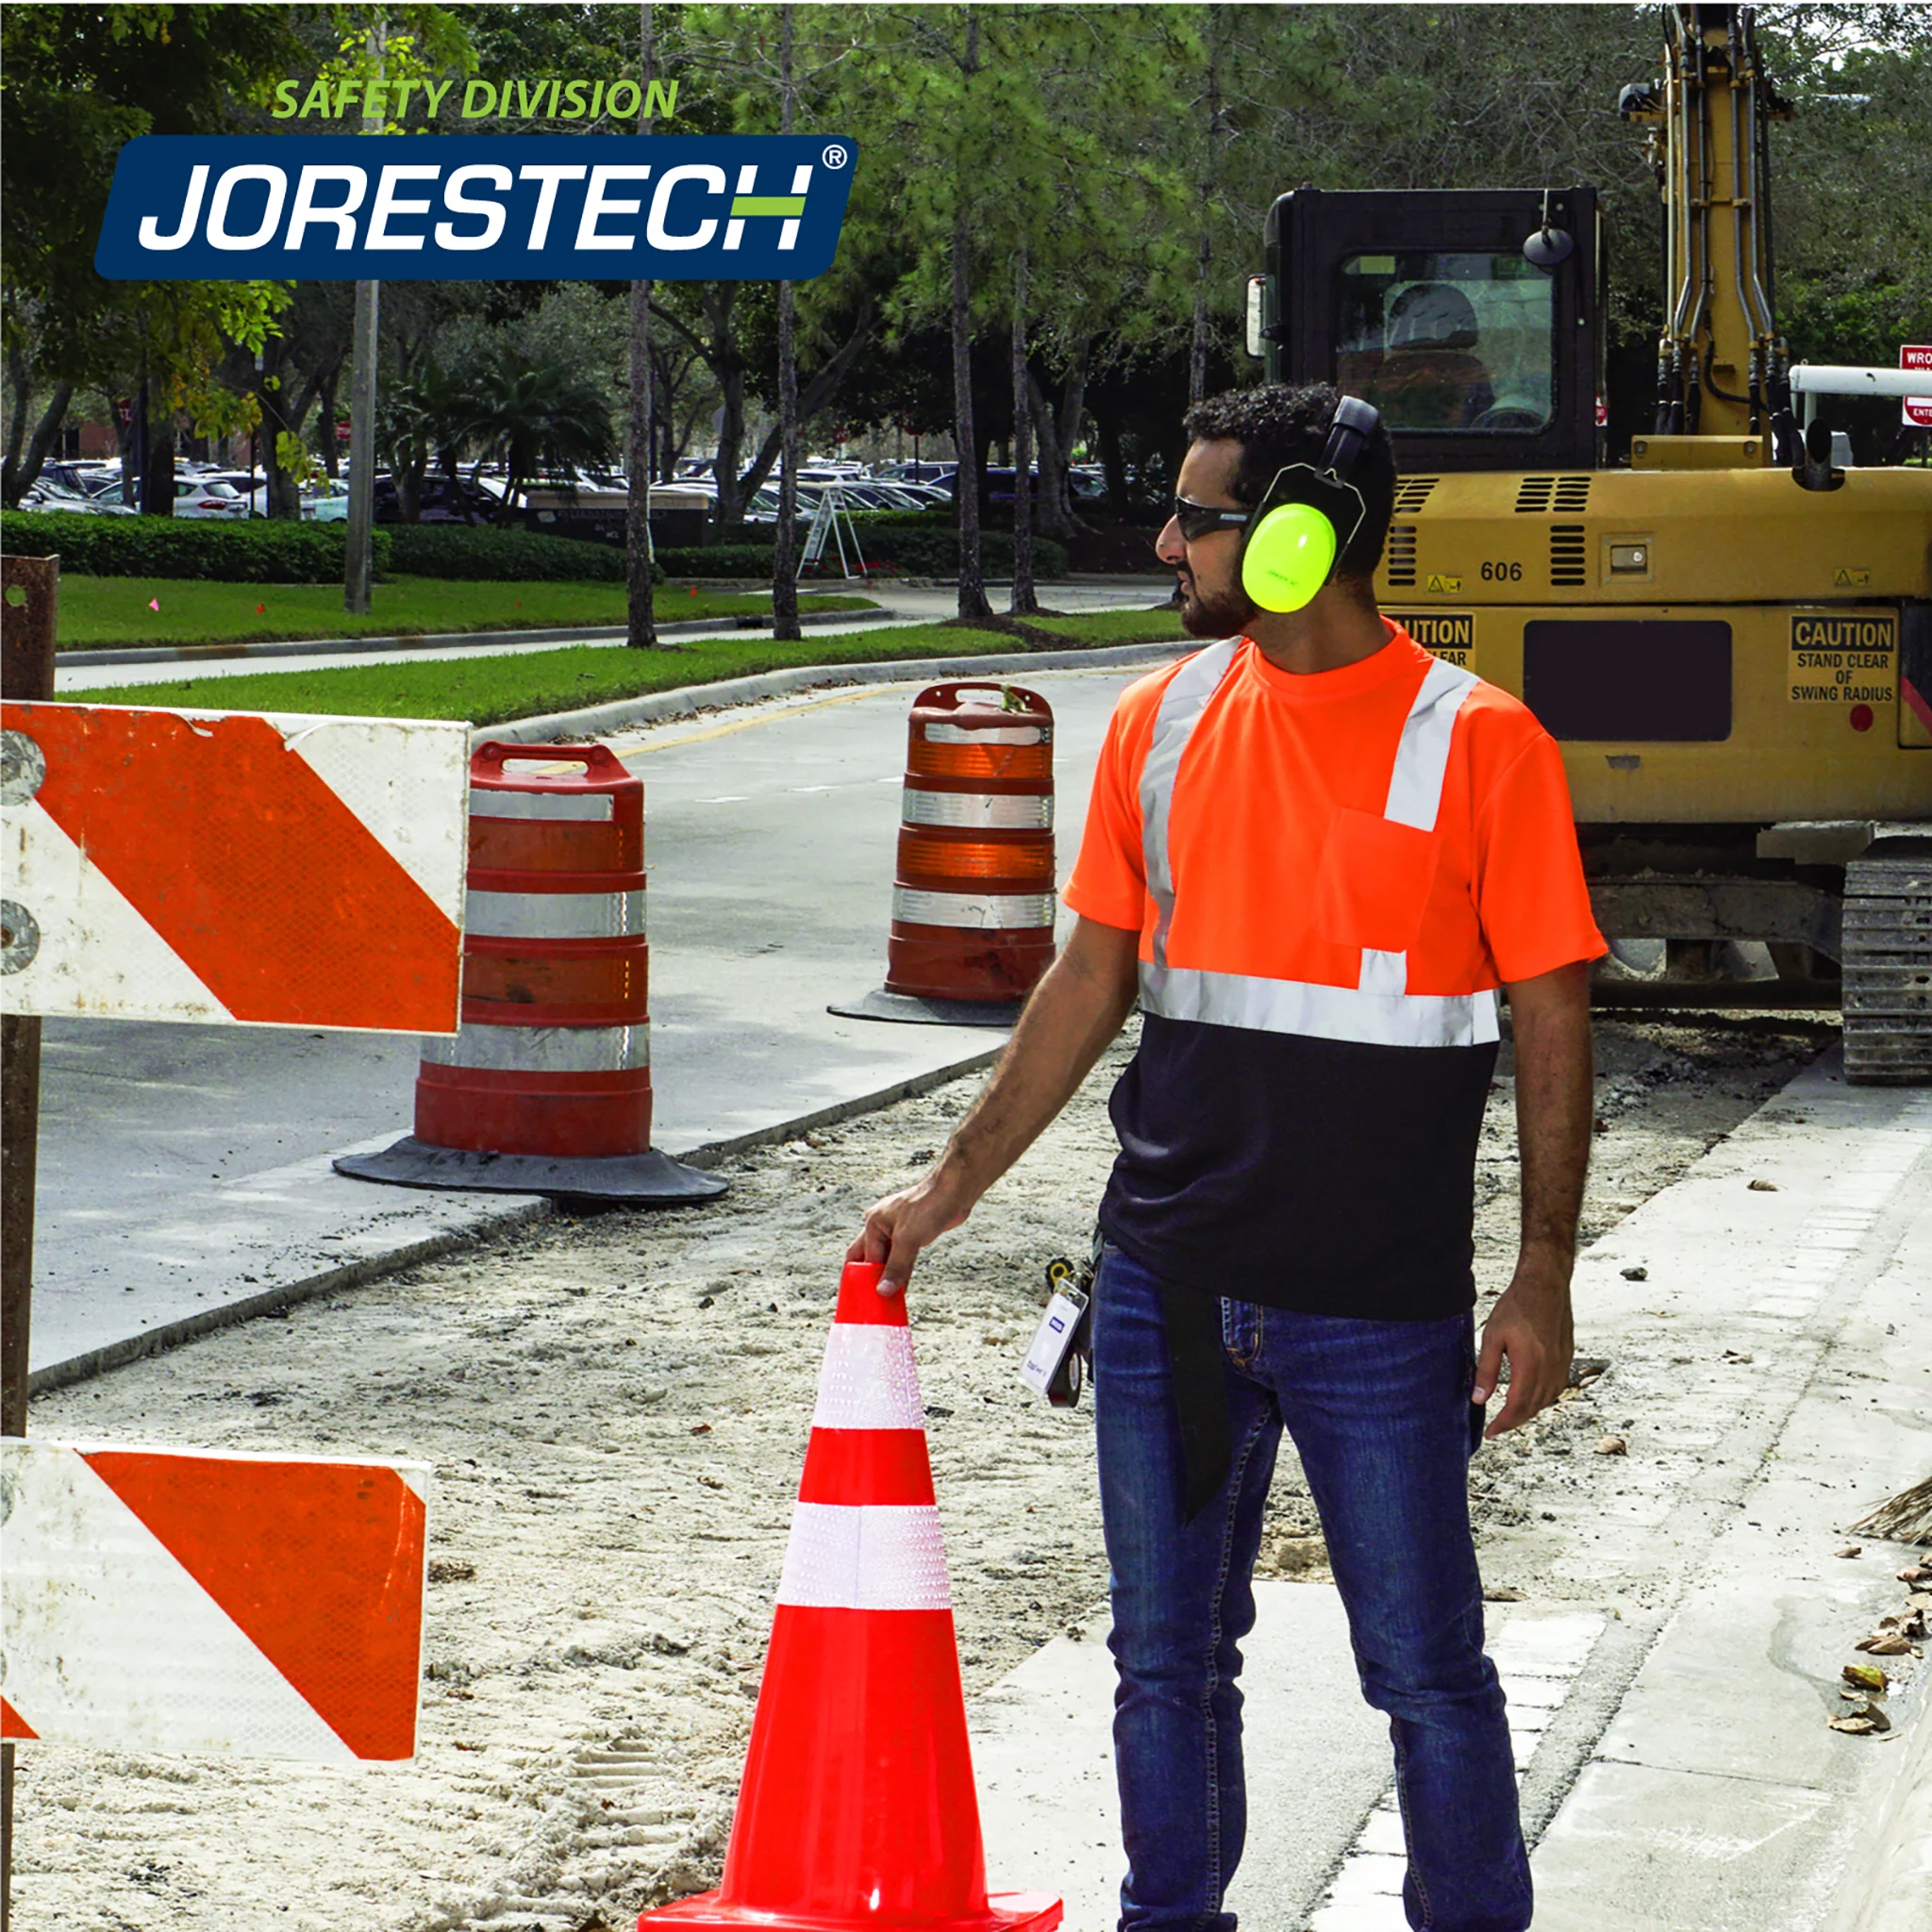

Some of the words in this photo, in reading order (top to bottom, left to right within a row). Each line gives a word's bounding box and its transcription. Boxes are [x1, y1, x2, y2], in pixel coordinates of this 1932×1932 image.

[1907, 352, 1932, 365] WRO
[1480, 561, 1523, 581] 606
[1404, 620, 1470, 643] UTION
[1795, 622, 1891, 646] CAUTION
[1797, 653, 1842, 668] STAND
[1846, 654, 1889, 669] CLEAR
[1835, 669, 1854, 685] OF
[1791, 685, 1839, 700] SWING
[1843, 686, 1893, 702] RADIUS
